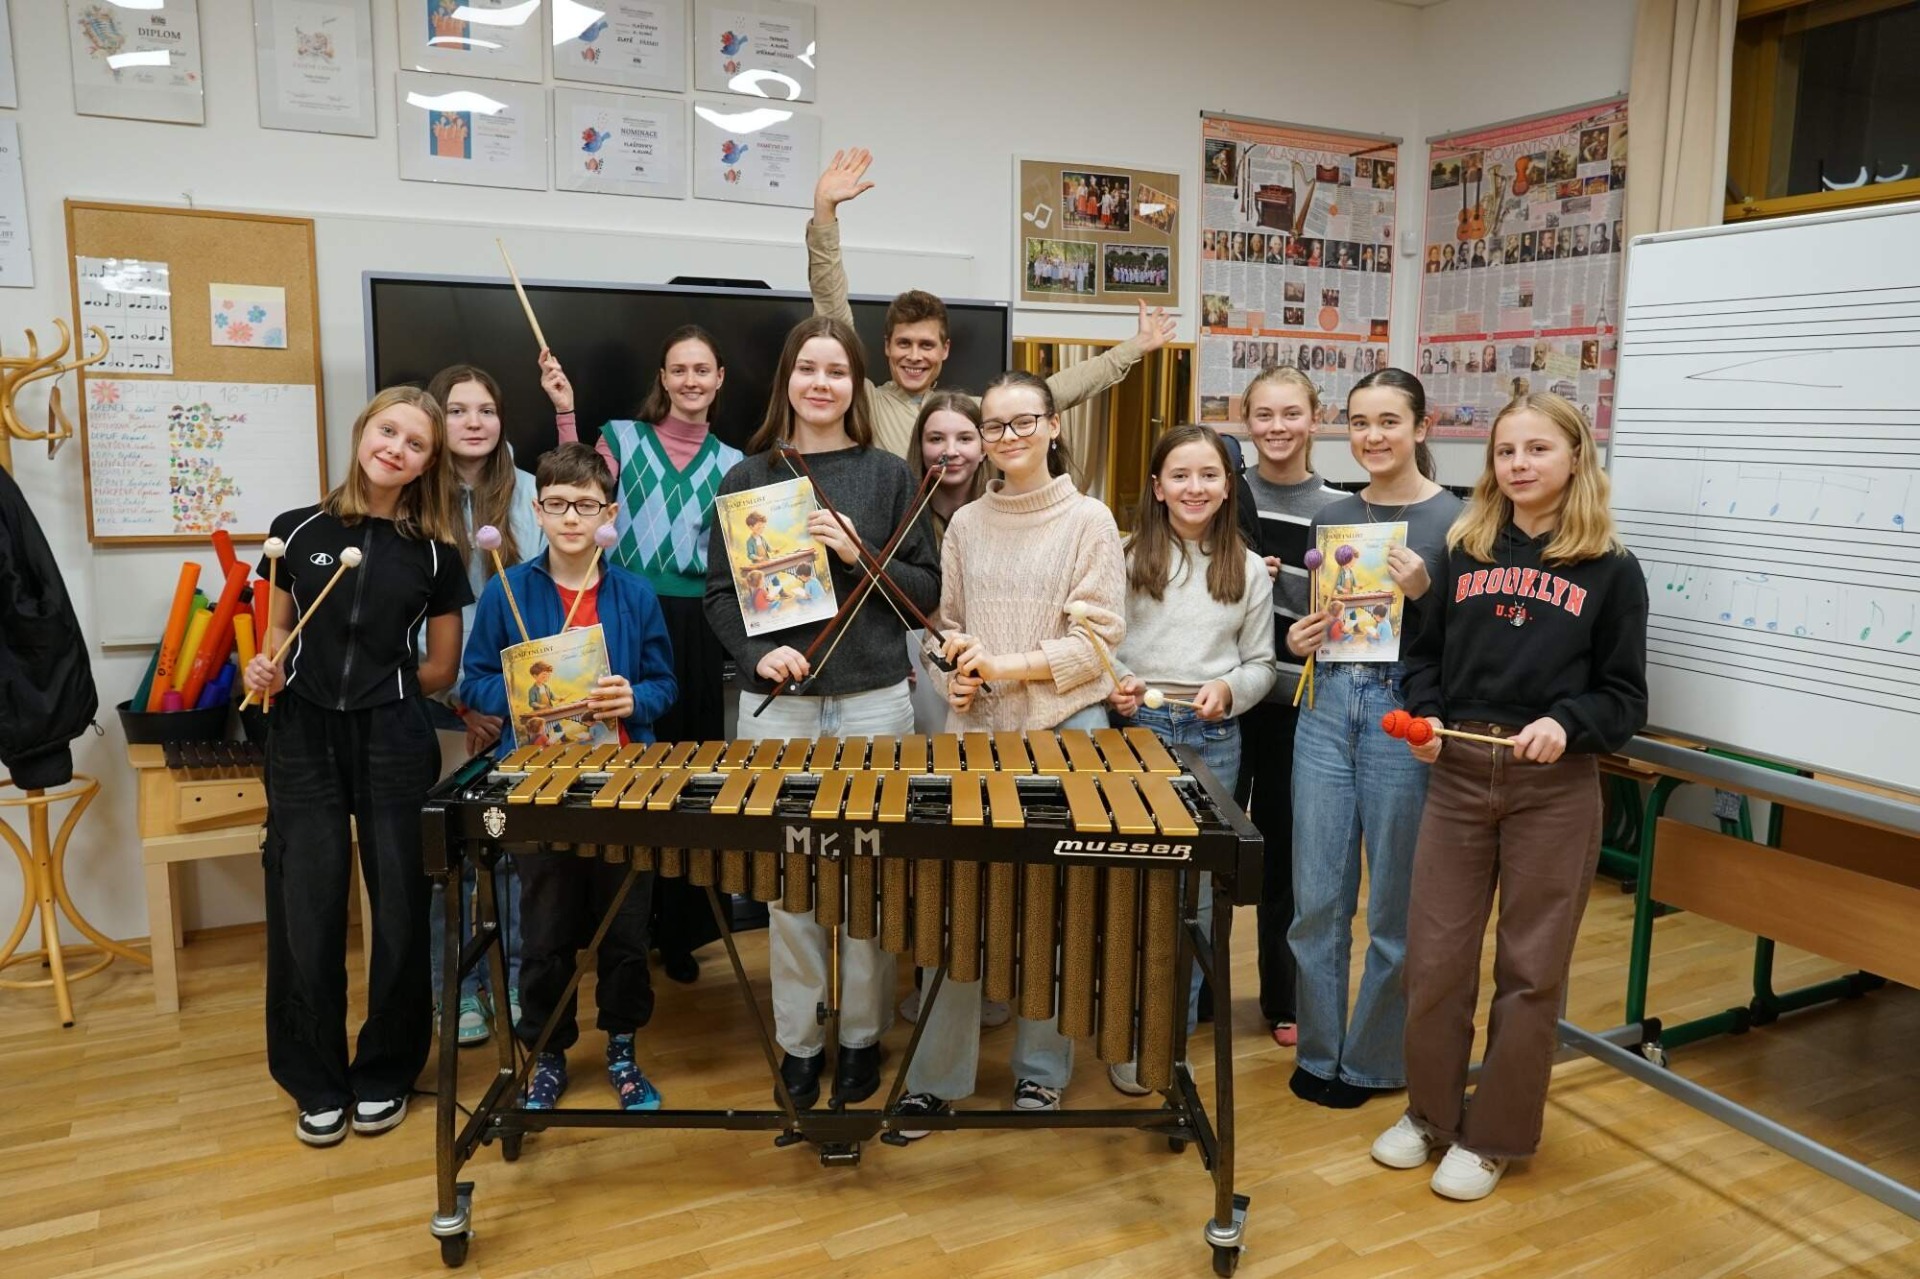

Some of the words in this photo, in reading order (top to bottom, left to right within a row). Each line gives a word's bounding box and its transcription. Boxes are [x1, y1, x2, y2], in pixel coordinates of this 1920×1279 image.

[137, 27, 181, 40] DIPLOM
[620, 128, 658, 139] NOMINACE
[1455, 567, 1587, 616] BROOKLYN
